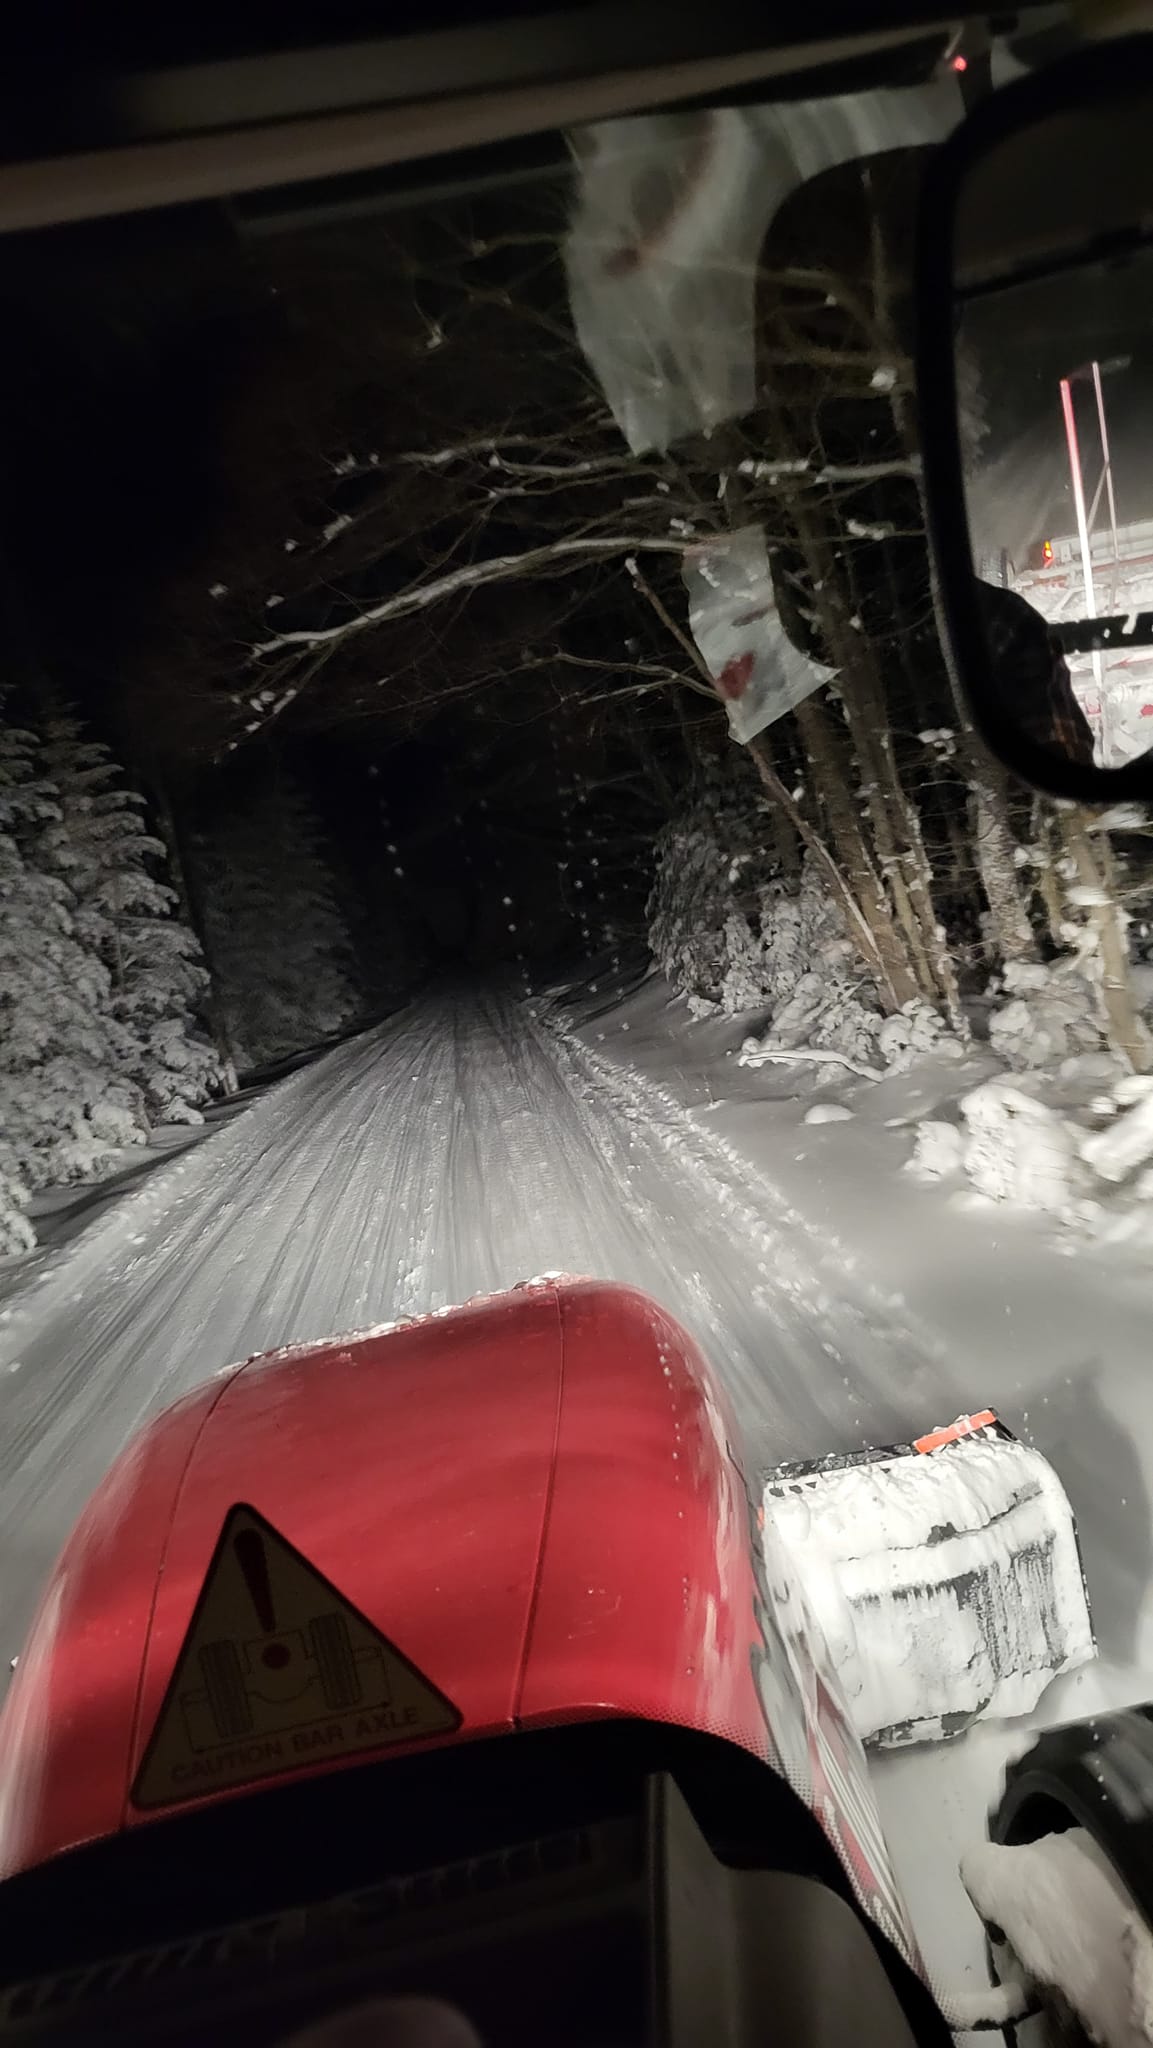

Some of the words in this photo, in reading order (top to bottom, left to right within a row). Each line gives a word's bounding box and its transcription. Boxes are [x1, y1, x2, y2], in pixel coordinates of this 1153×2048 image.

[172, 1741, 282, 1780] CAUTION
[293, 1726, 345, 1752] BAR
[357, 1707, 419, 1736] AXLE
